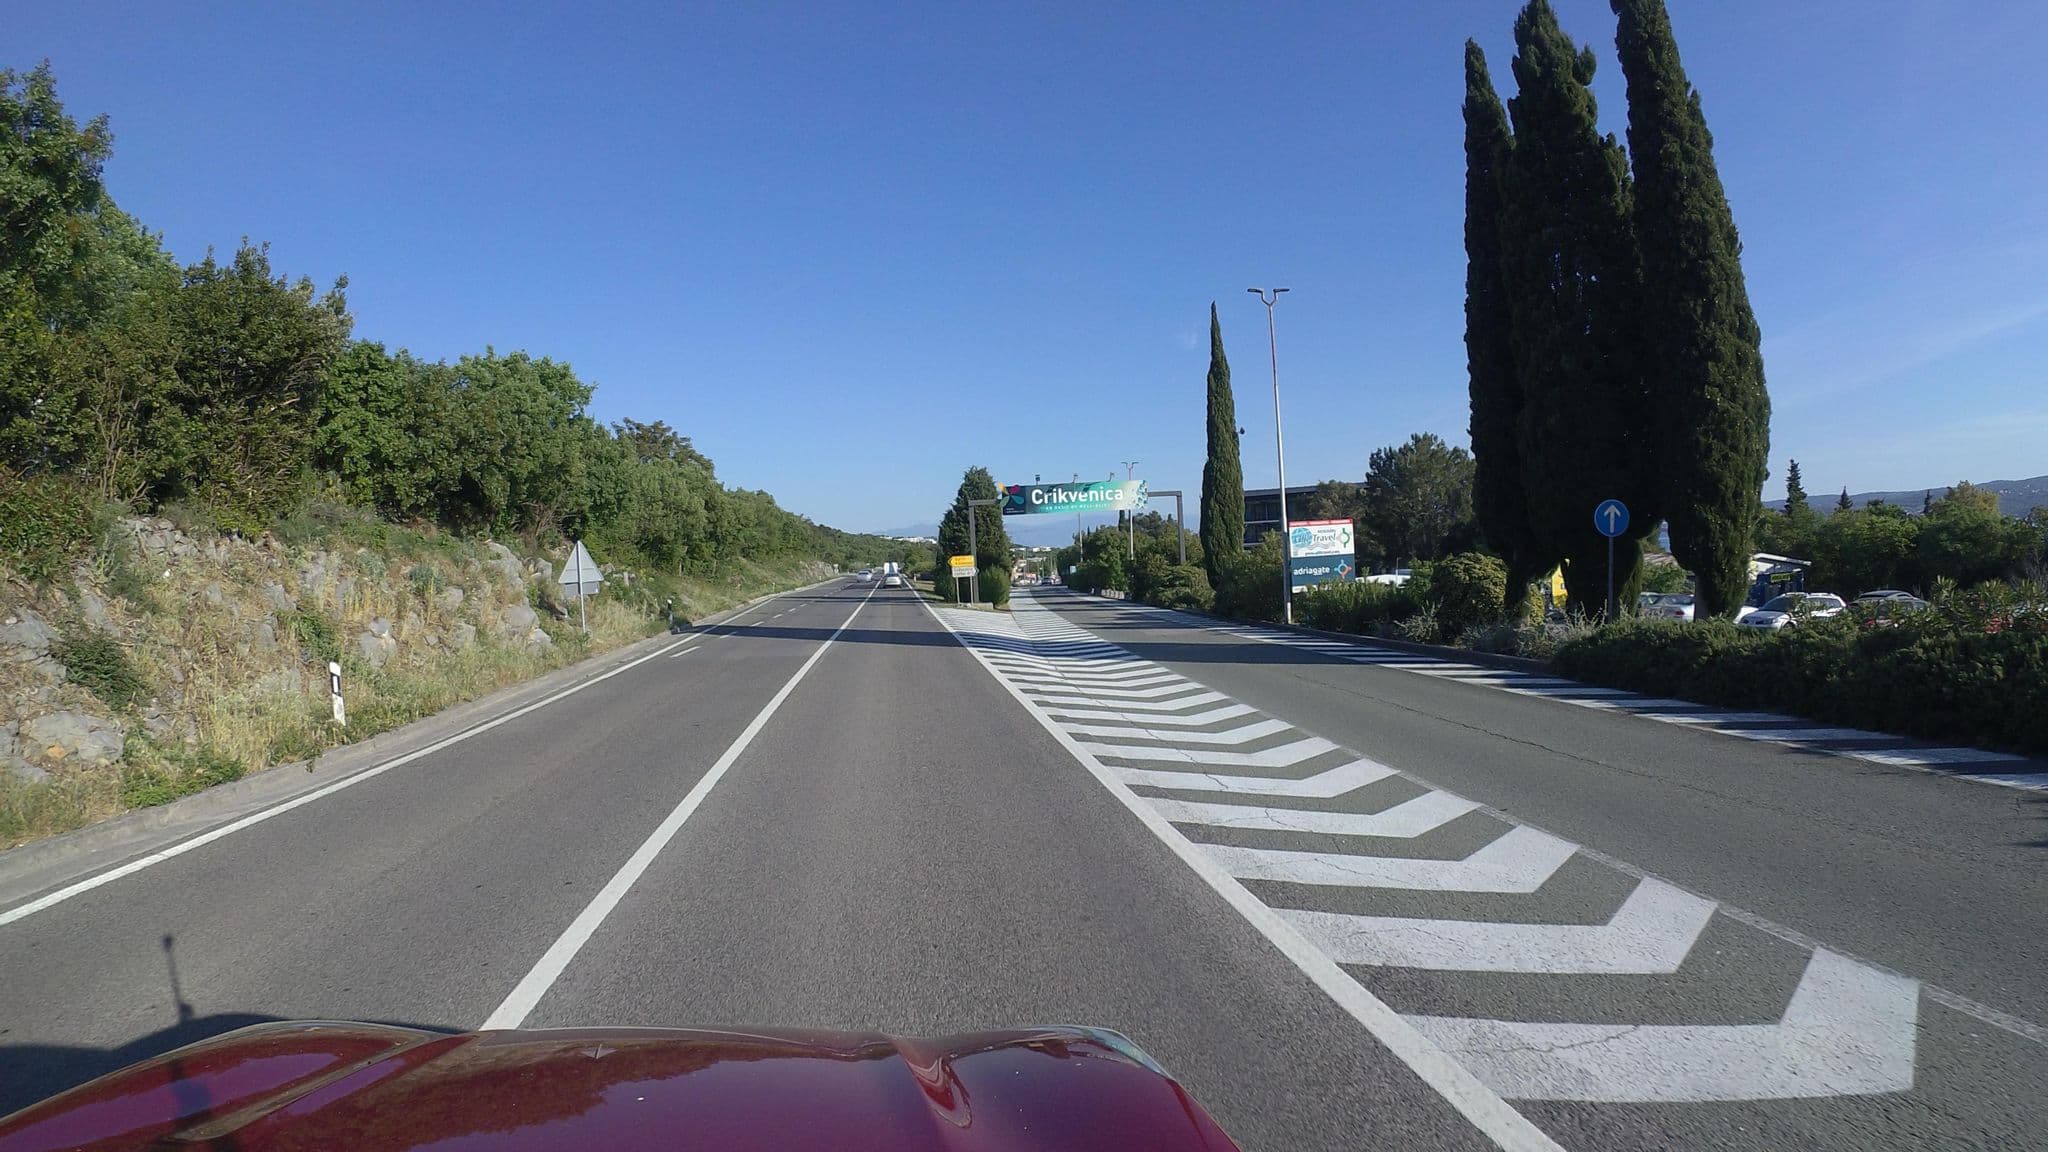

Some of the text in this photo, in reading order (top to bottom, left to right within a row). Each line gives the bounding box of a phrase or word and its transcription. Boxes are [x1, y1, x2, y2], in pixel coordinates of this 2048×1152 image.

[1031, 487, 1124, 505] Crikvenica
[1312, 532, 1336, 542] Travel
[1293, 566, 1330, 576] adriagate
